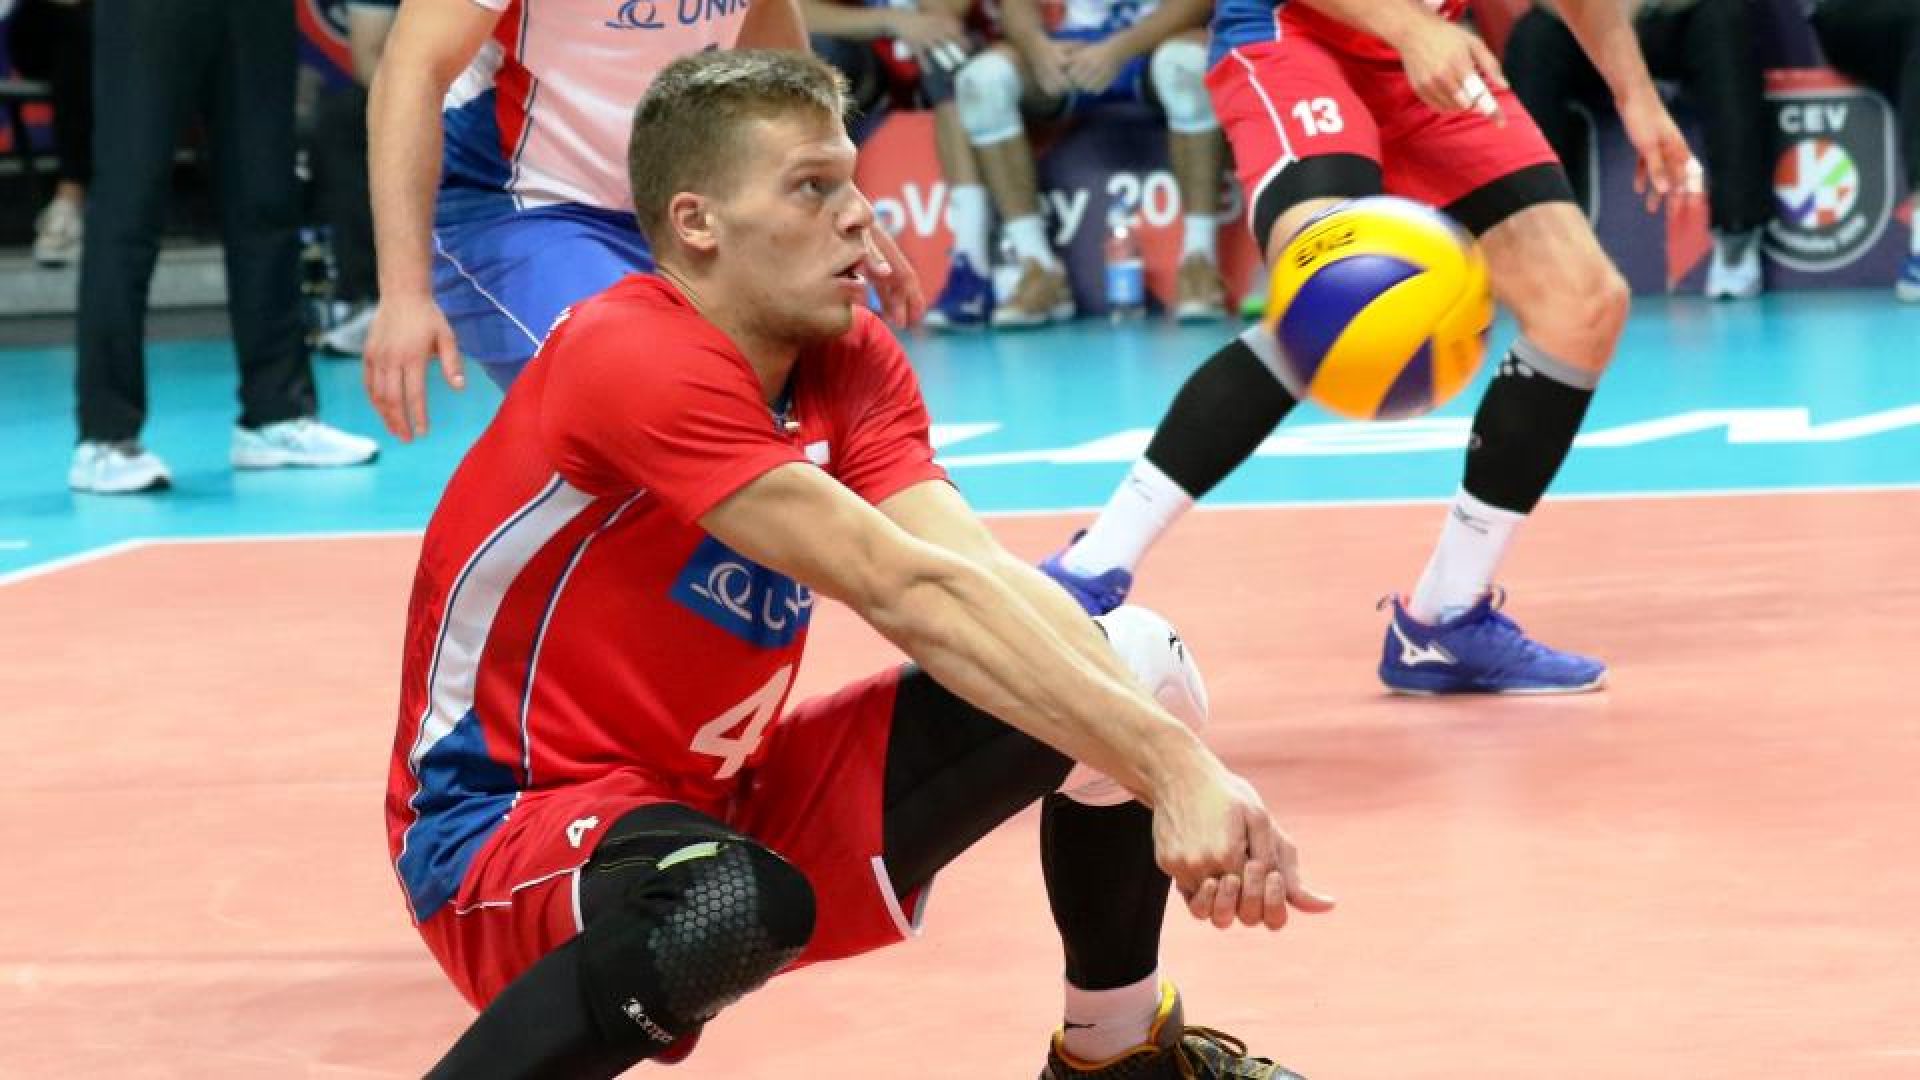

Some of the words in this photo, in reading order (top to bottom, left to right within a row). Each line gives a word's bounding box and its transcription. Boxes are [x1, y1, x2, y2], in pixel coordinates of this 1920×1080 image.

[1291, 97, 1344, 136] 13
[1778, 104, 1848, 132] CEV
[689, 663, 793, 780] 4
